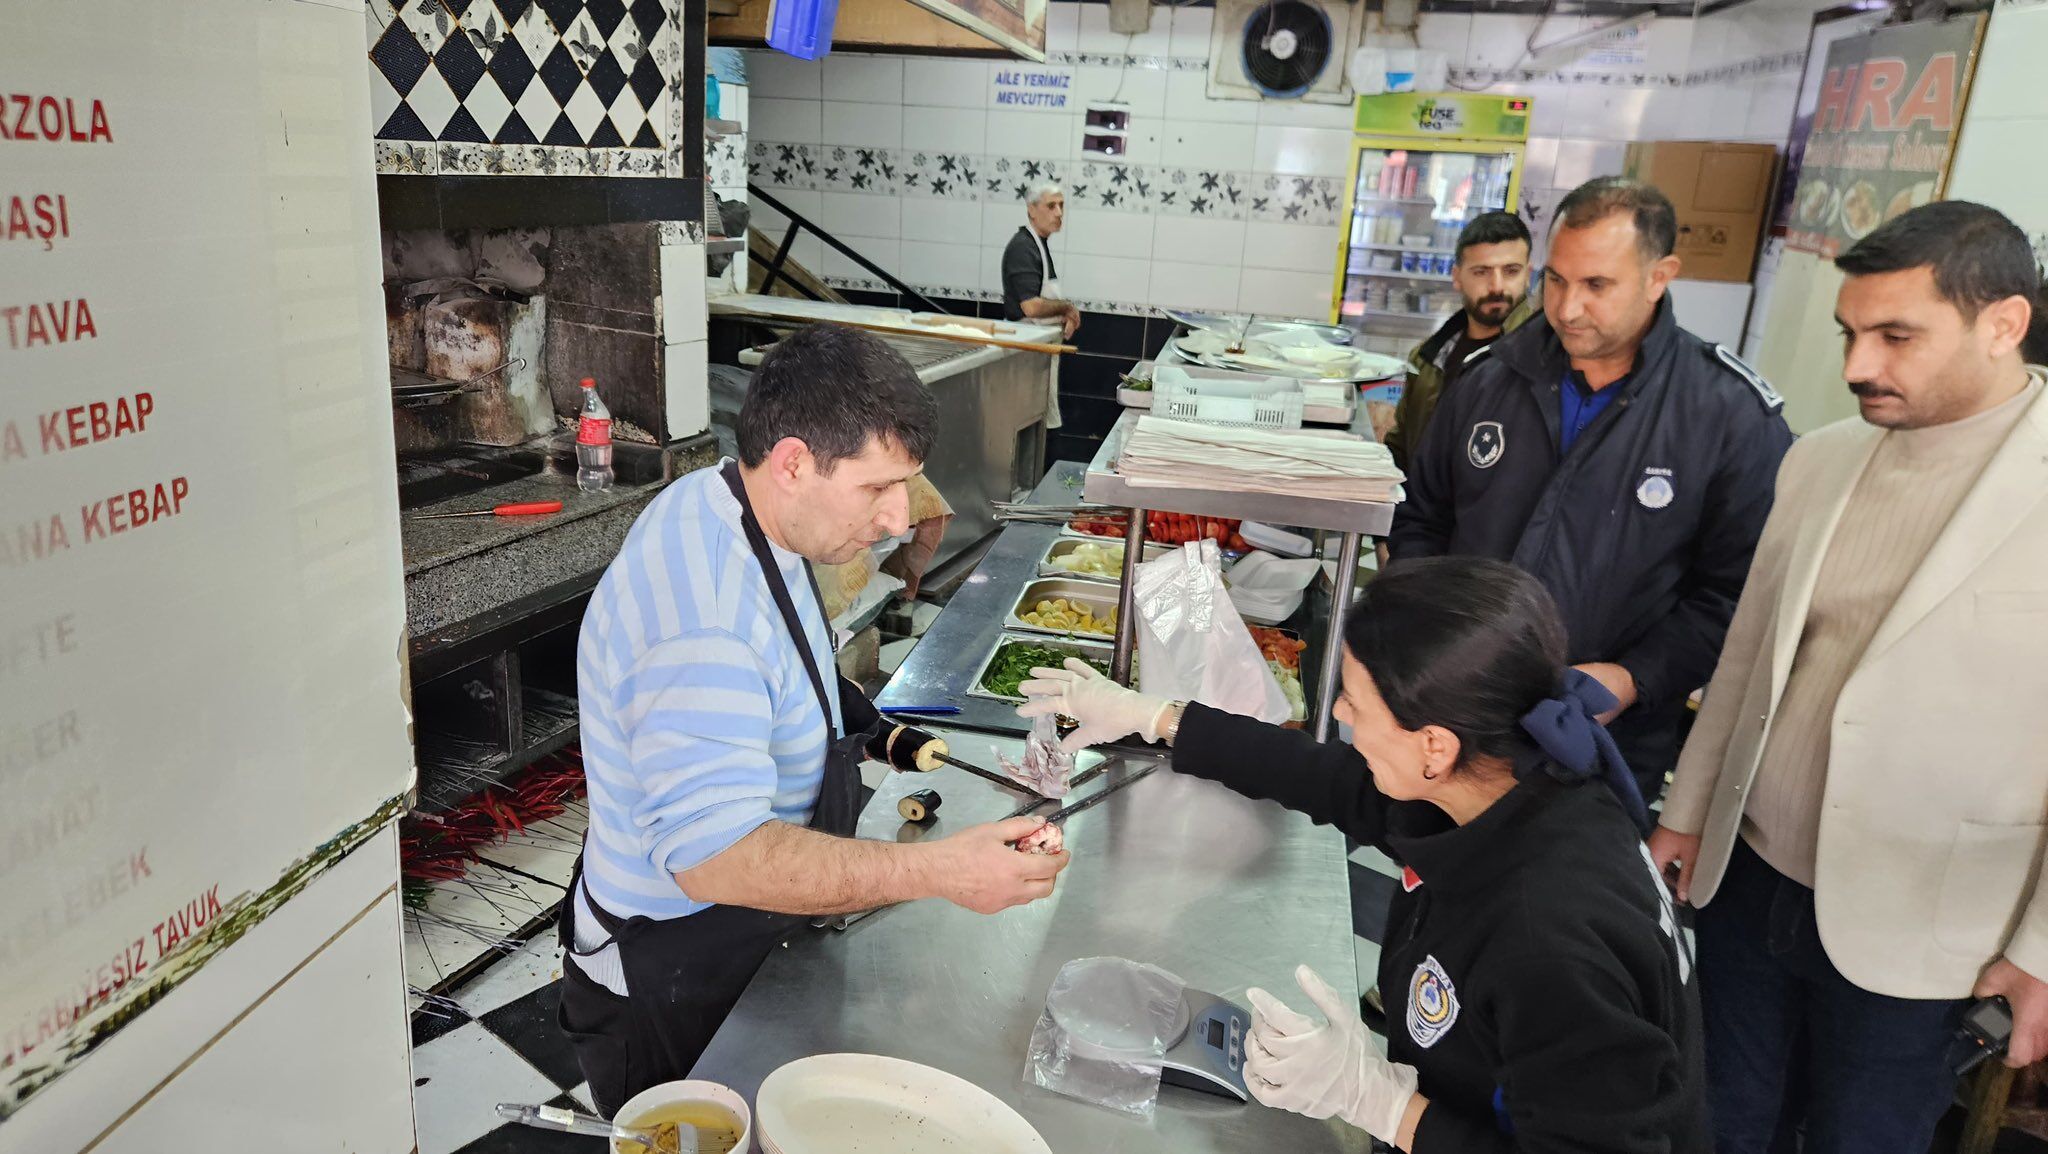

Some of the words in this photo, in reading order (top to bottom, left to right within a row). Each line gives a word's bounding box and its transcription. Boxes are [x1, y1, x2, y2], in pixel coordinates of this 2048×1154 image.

[995, 68, 1020, 86] AİLE
[1023, 70, 1071, 89] YERİMİZ
[996, 91, 1067, 107] MEVCUTTUR
[0, 194, 70, 251] AŞI
[0, 298, 97, 350] TAVA
[38, 391, 155, 455] KEBAP
[81, 476, 190, 544] KEBAP
[152, 882, 222, 960] TAVUK
